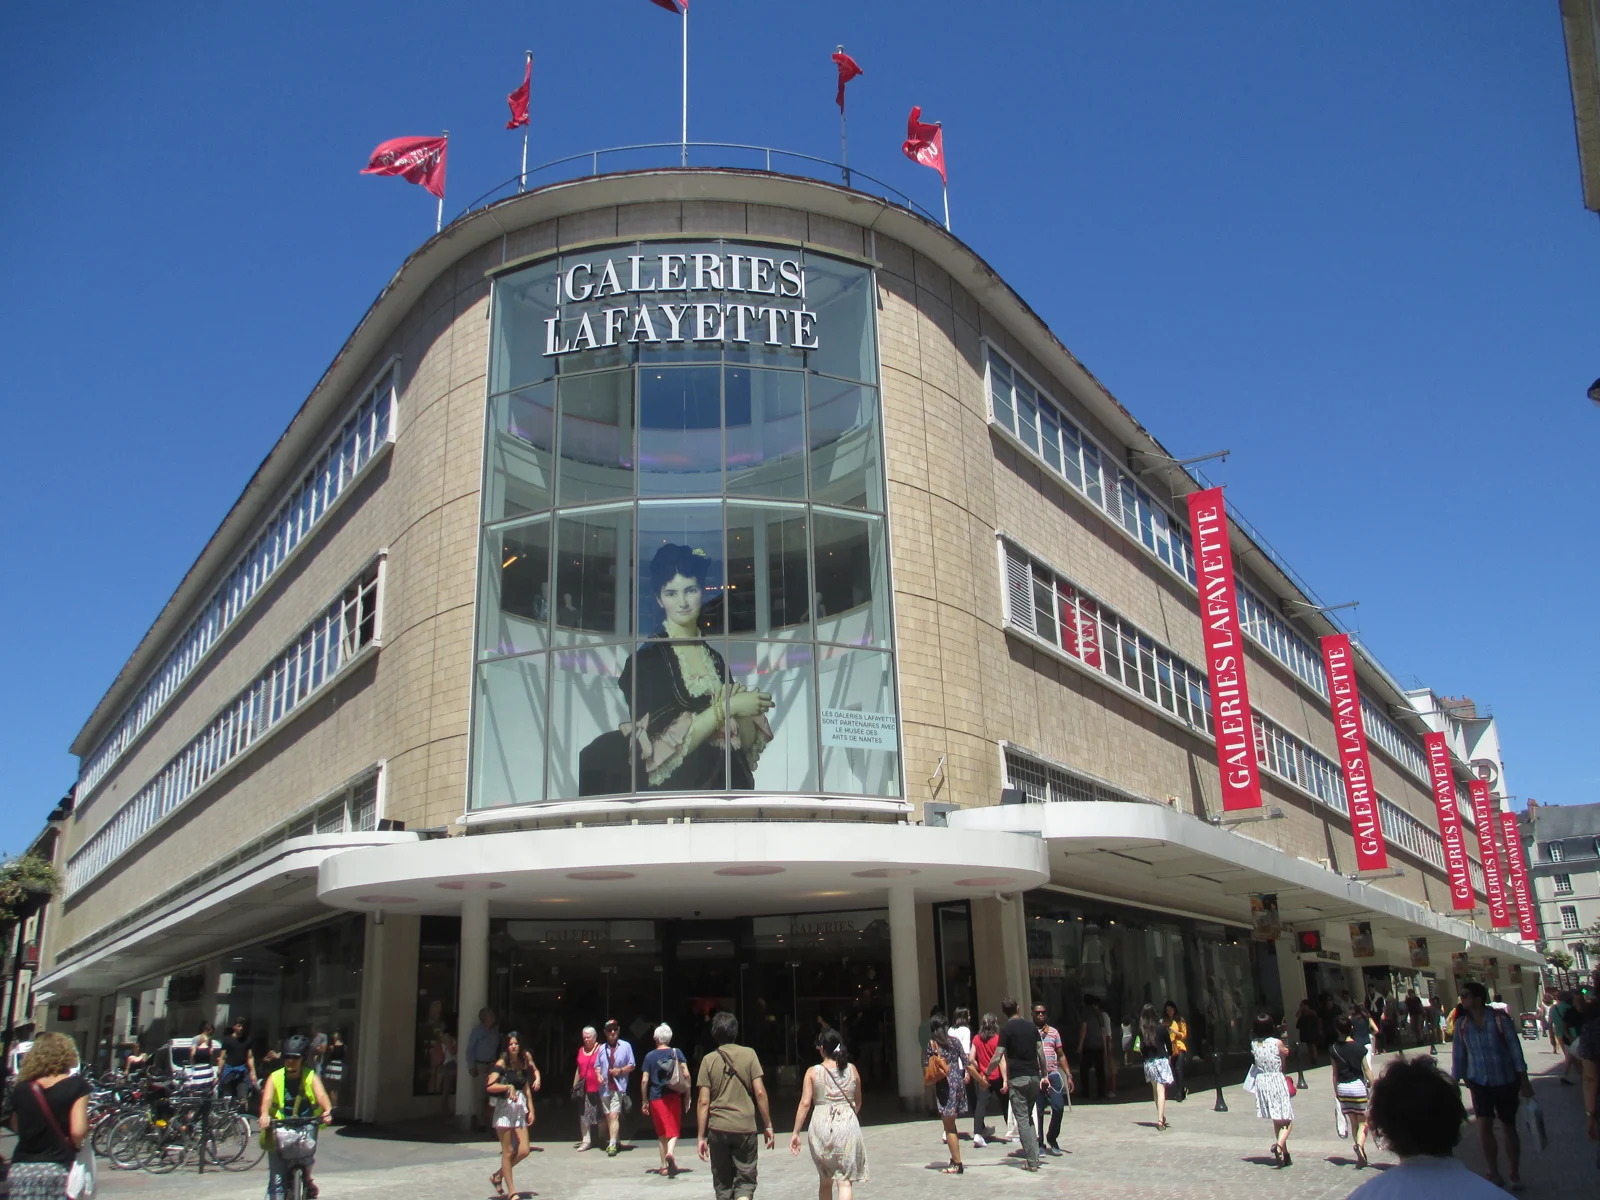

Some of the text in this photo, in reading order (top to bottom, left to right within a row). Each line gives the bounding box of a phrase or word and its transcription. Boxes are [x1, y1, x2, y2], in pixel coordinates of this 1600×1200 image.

[565, 253, 802, 301] GALERIES
[543, 303, 818, 356] LAFAYETTE
[1197, 506, 1251, 789] GALERIES LAFAYETTE
[835, 712, 863, 720] GALERIES
[864, 715, 896, 723] LAFAYETTE
[840, 720, 879, 728] PARTENAIRES
[1328, 647, 1378, 855] GALERIES LAFAYETTE
[1430, 741, 1469, 899] GALERIES LAFAYETTE
[1474, 788, 1494, 852] LAFAYETTE
[1484, 855, 1504, 919] GALERIES
[1504, 819, 1533, 933] GALERIES LAFAYETTE
